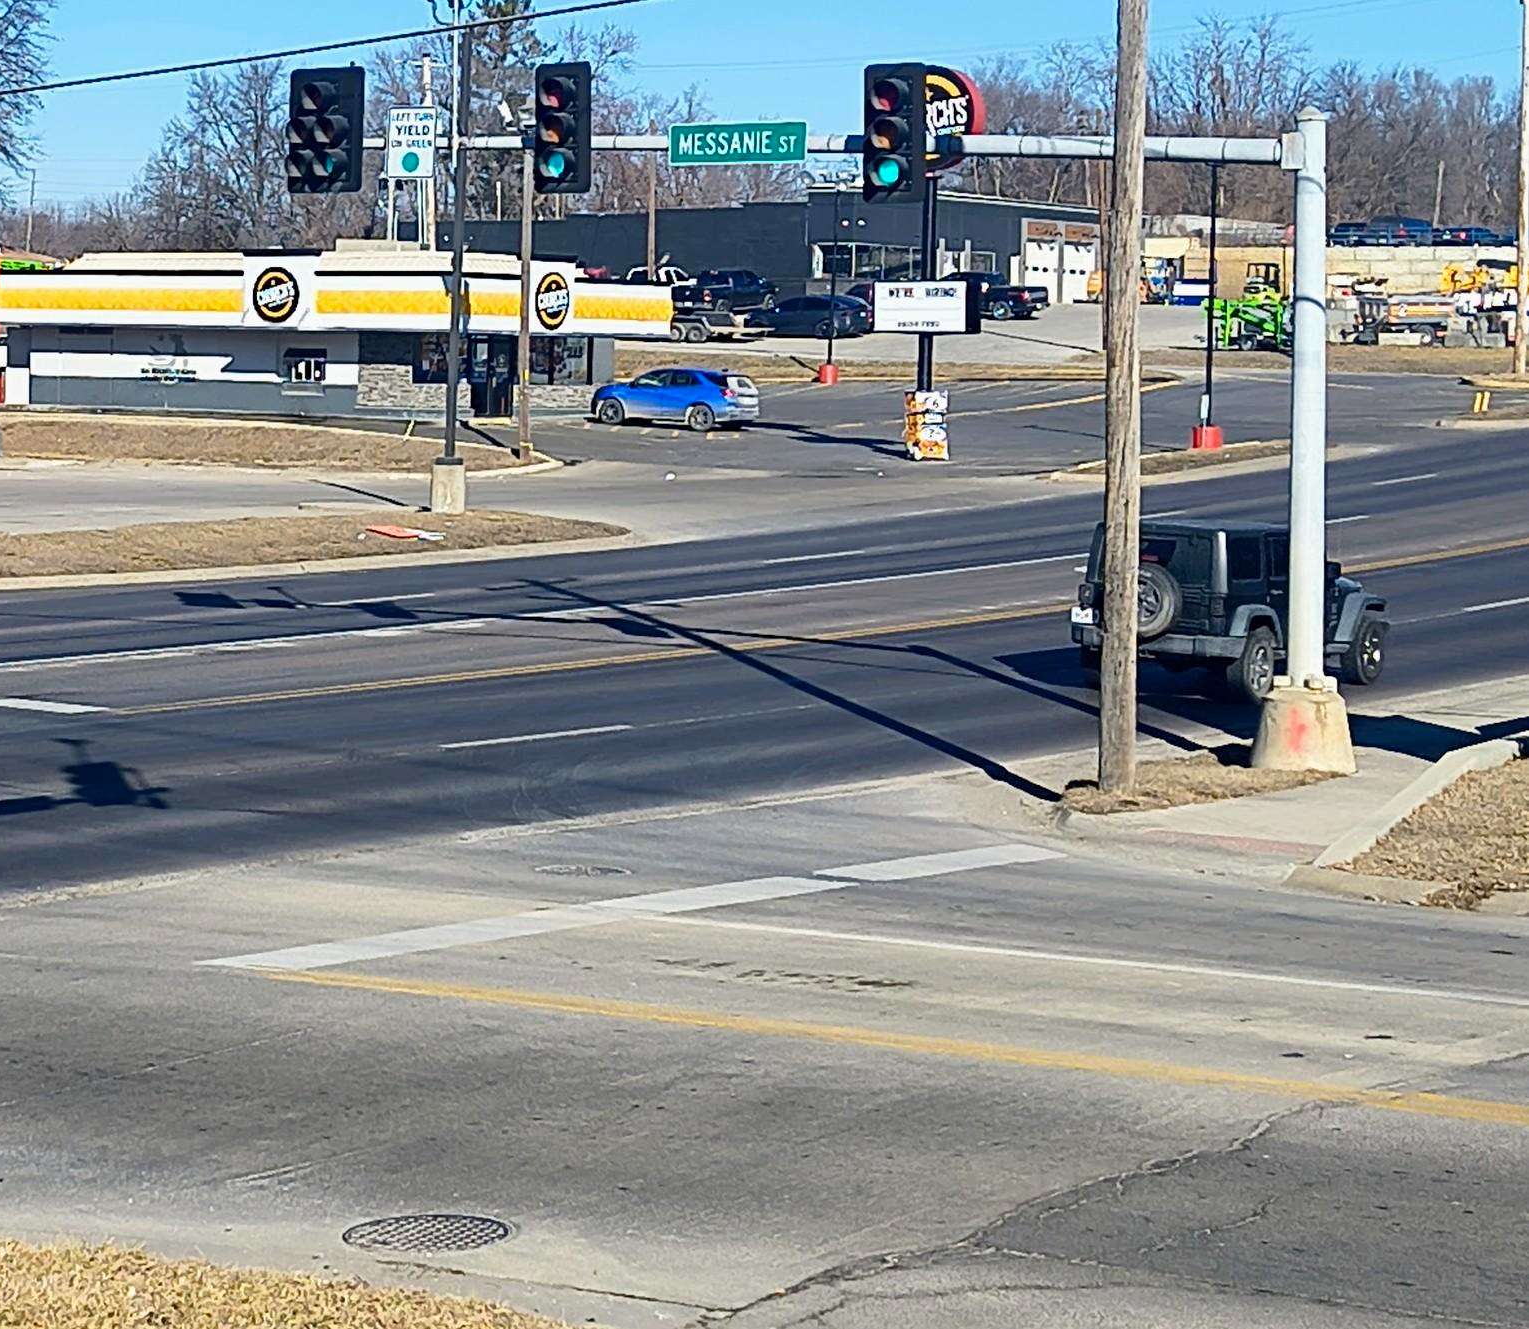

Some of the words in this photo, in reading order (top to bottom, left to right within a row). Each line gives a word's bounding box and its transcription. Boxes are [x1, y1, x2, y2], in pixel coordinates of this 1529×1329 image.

[925, 97, 968, 137] RCH'S
[396, 125, 430, 135] YIELD
[678, 131, 772, 155] MESSANIE
[779, 136, 797, 153] ST
